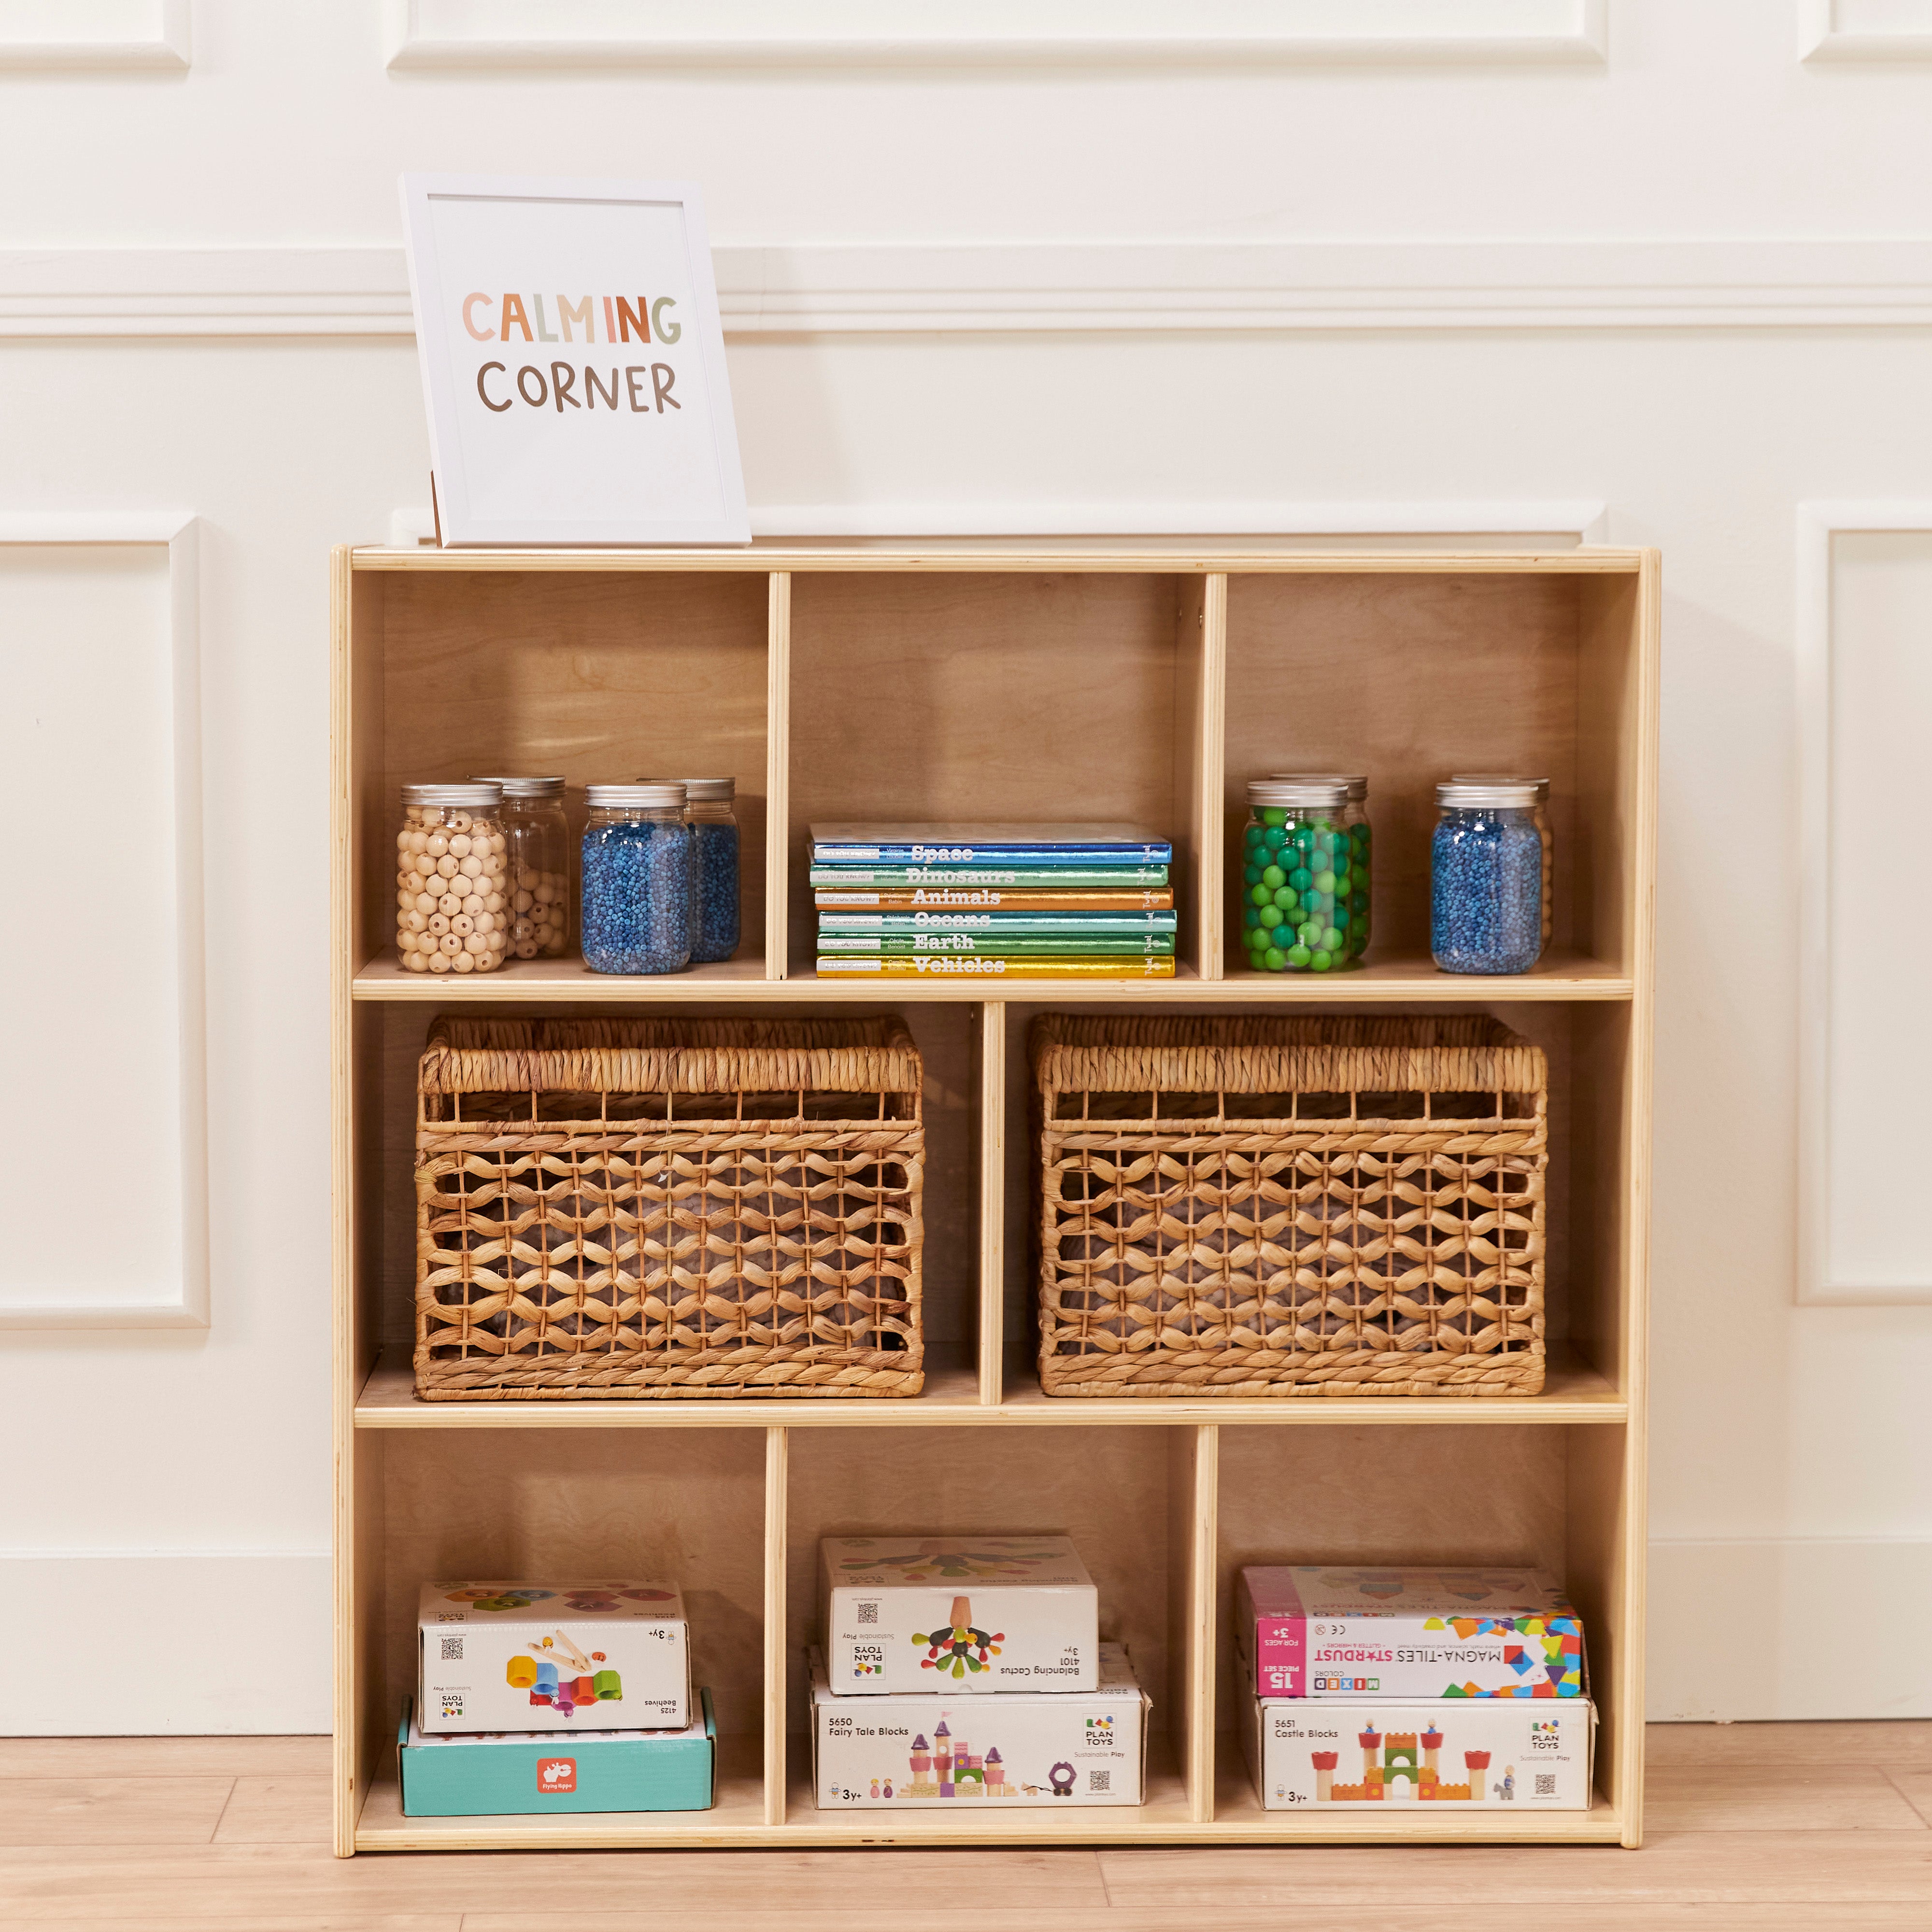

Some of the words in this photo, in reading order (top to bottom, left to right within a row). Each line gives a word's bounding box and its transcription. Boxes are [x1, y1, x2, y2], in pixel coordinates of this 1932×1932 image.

[462, 292, 682, 344] CALMING
[477, 361, 682, 413] CORNER
[911, 845, 973, 864] Space
[906, 867, 1015, 883] Dinosaurs
[911, 889, 1001, 905] Animals
[914, 912, 990, 927] Oceans
[913, 934, 975, 950] Earth
[912, 957, 1005, 973] Vehicles
[649, 1629, 665, 1639] 3y+
[1273, 1628, 1289, 1638] 3+
[1035, 1666, 1080, 1675] Balancing
[1269, 1672, 1293, 1689] 15
[1315, 1678, 1378, 1690] MIXED
[829, 1728, 852, 1737] Fairy
[843, 1790, 862, 1801] 3y+
[1289, 1791, 1307, 1803] 3y+
